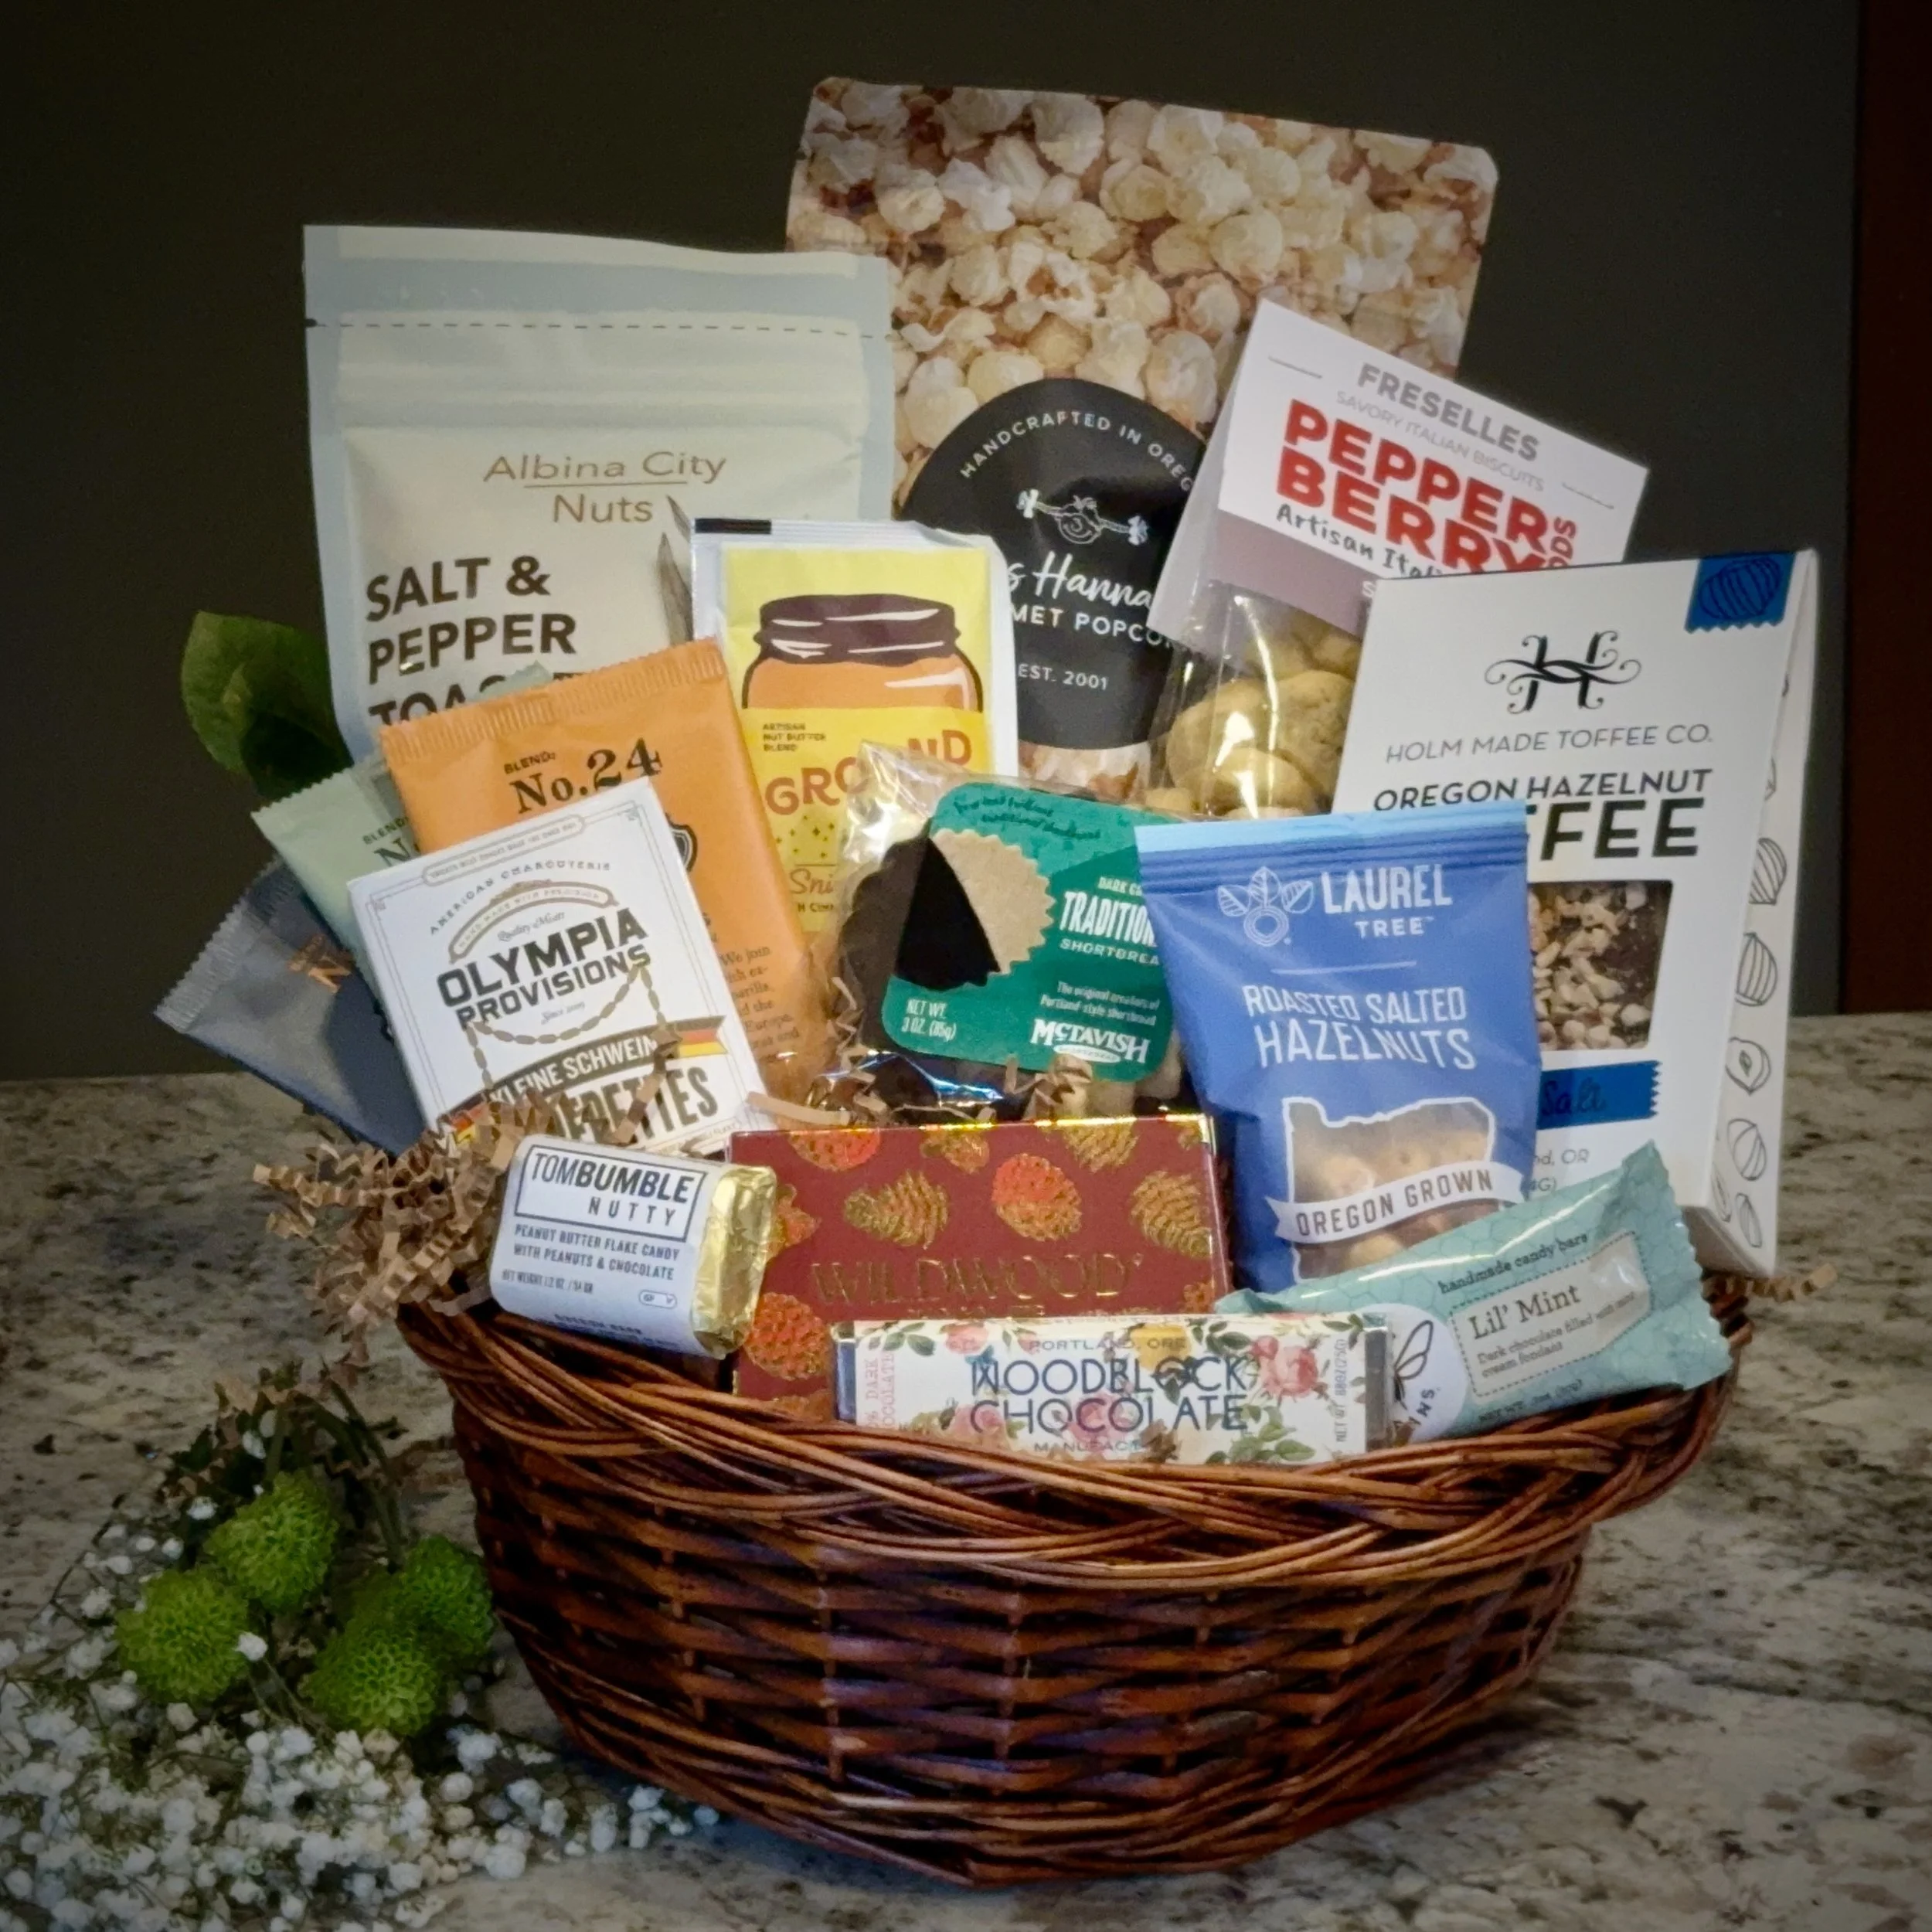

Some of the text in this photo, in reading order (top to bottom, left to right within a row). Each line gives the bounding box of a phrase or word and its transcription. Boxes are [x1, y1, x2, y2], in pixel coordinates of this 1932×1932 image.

[1357, 362, 1541, 462] FRESELLES
[960, 410, 1194, 492] HANDCRAFTED IN OREG
[1336, 391, 1545, 492] SAVORY ITALIAN BISCUITS
[483, 451, 726, 484] Albina City
[1284, 398, 1549, 554] PEPPER
[553, 493, 653, 522] Nuts
[1277, 504, 1374, 560] Artisan
[366, 555, 551, 622] SALT &
[369, 612, 577, 685] PEPPER
[1018, 663, 1107, 689] EST. 2001
[1386, 723, 1713, 764] HOLM MADE TOFFEE CO.
[1374, 768, 1713, 813] OREGON HAZELNUT
[430, 876, 495, 935] AMERICAN
[1320, 864, 1453, 914] LAUREL
[437, 906, 648, 1008] OLYMPIA
[1060, 937, 1159, 966] SHORTBREA
[454, 944, 651, 1032] PROVISIONS
[906, 998, 927, 1015] NET
[1242, 985, 1467, 1026] ROASTED SALTED
[1253, 1018, 1477, 1071] HAZELNUTS
[532, 1153, 694, 1204] TOMBUMBLE
[1296, 1169, 1493, 1236] OREGON GROWN
[588, 1196, 675, 1227] NUTTY
[514, 1243, 674, 1281] WITH PEANUTS & CHOCOLATE
[515, 1223, 680, 1261] PEANUT BUTTER FLAKE CANDY
[811, 1253, 1128, 1306] WILDWOOD
[1437, 1260, 1512, 1294] handmade
[1515, 1243, 1556, 1267] candy
[1515, 1285, 1580, 1323] Mint
[971, 1355, 1250, 1396] WOODBLOCK
[971, 1394, 1249, 1436] CHOCOLATE
